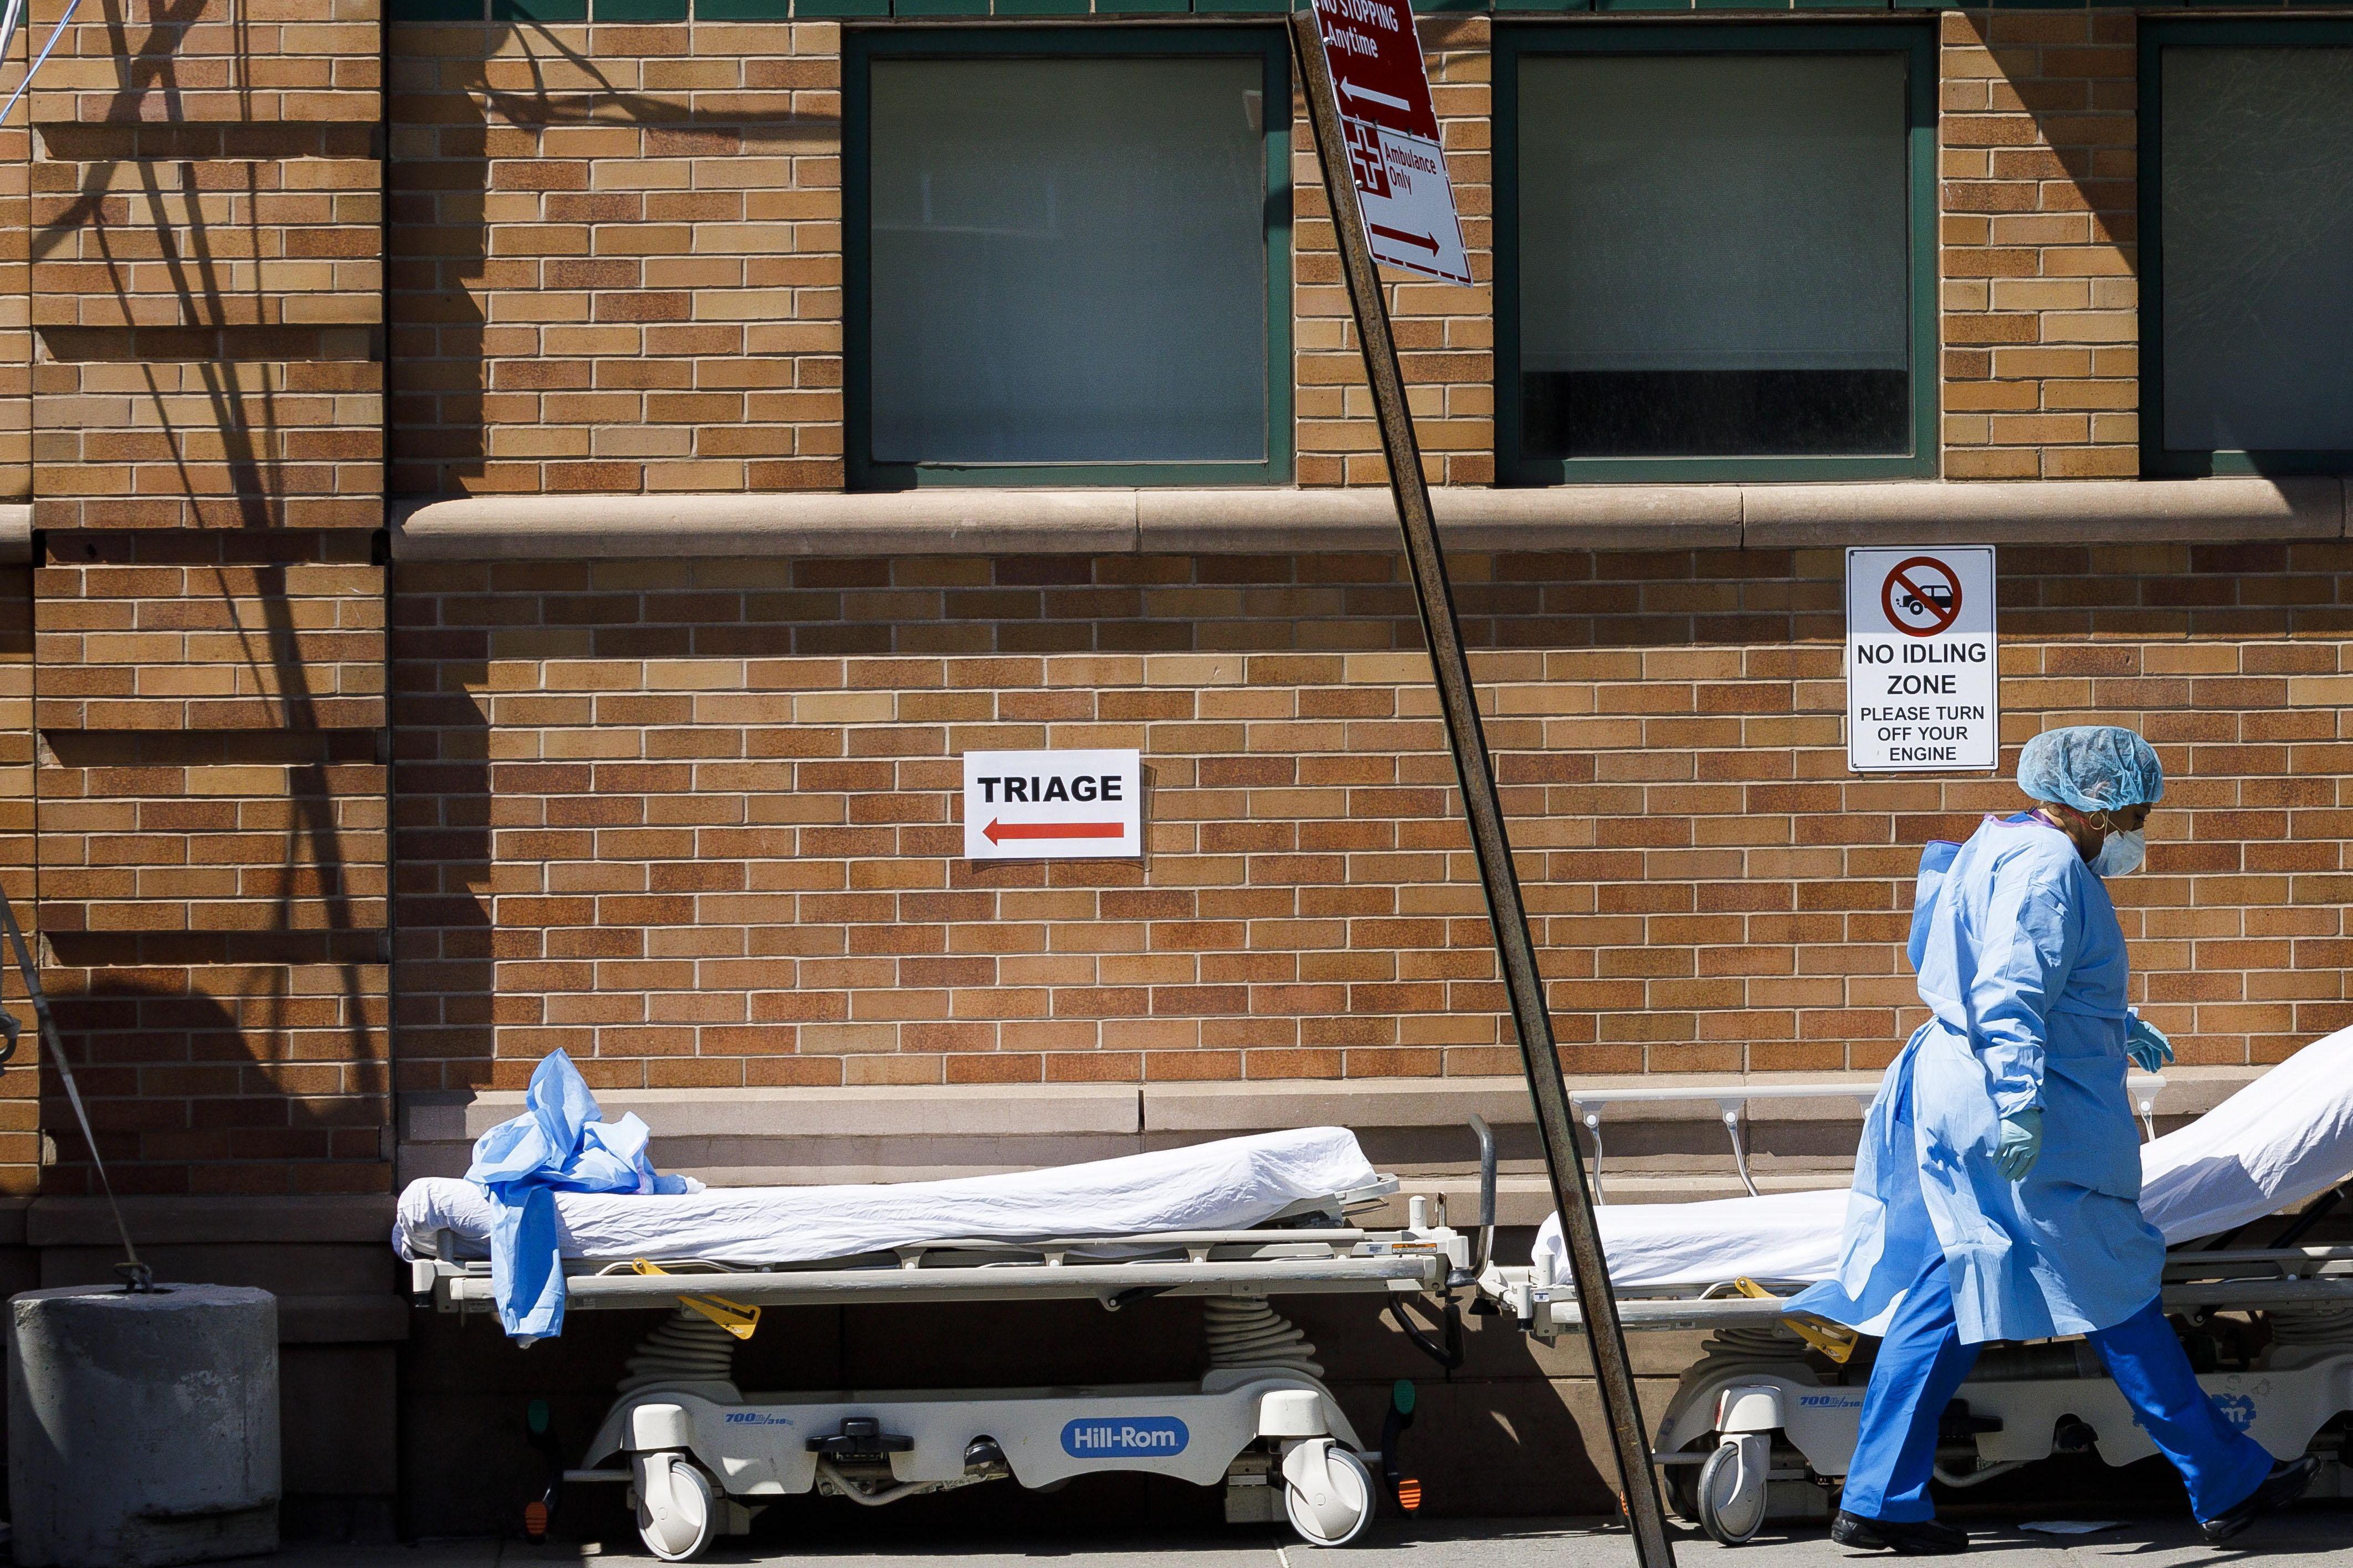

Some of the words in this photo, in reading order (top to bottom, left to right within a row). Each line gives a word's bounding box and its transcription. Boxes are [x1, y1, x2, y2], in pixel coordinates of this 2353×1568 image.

[1340, 0, 1398, 32] STOPPING
[1327, 20, 1378, 58] Anytime
[1385, 142, 1437, 175] Ambulance
[1389, 166, 1412, 195] Only
[1858, 644, 1894, 664] NO
[1904, 643, 1986, 664] IDLING
[1887, 675, 1956, 695] ZONE
[1861, 706, 1930, 721] PLEASE
[1936, 706, 1985, 720] TURN
[1878, 727, 1911, 741] OFF
[1918, 726, 1968, 741] YOUR
[1890, 747, 1956, 761] ENGINE
[977, 775, 1122, 803] TRIAGE
[1075, 1426, 1175, 1448] Hill-Rom
